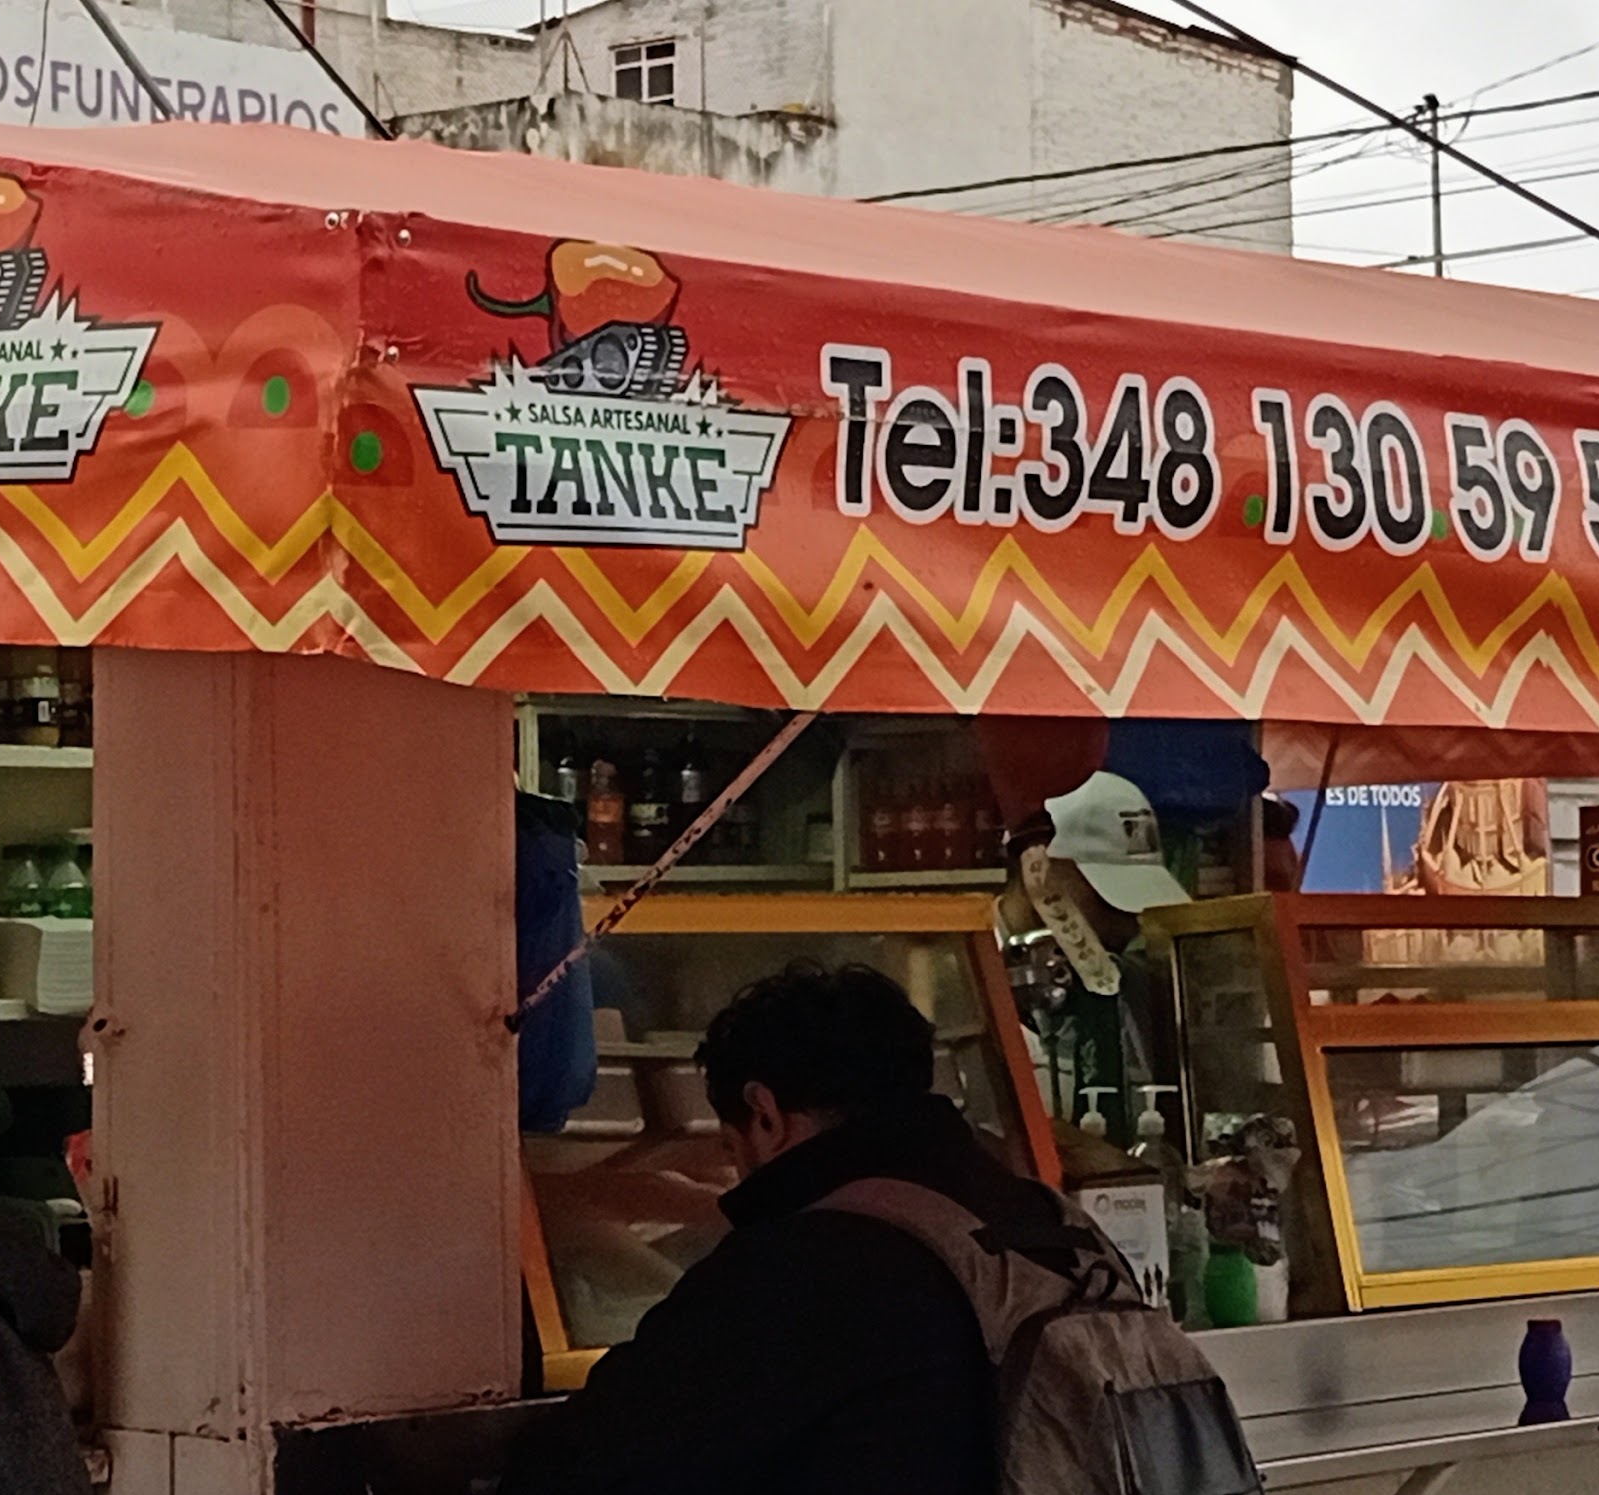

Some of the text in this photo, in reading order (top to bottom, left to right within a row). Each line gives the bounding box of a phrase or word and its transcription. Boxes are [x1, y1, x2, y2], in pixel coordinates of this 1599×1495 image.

[528, 403, 691, 435] SALSA ARTESANAL
[495, 432, 737, 523] TANKE
[1256, 399, 1427, 546] 130
[1455, 423, 1555, 553] 59
[1325, 784, 1421, 807] ES DE TODOS
